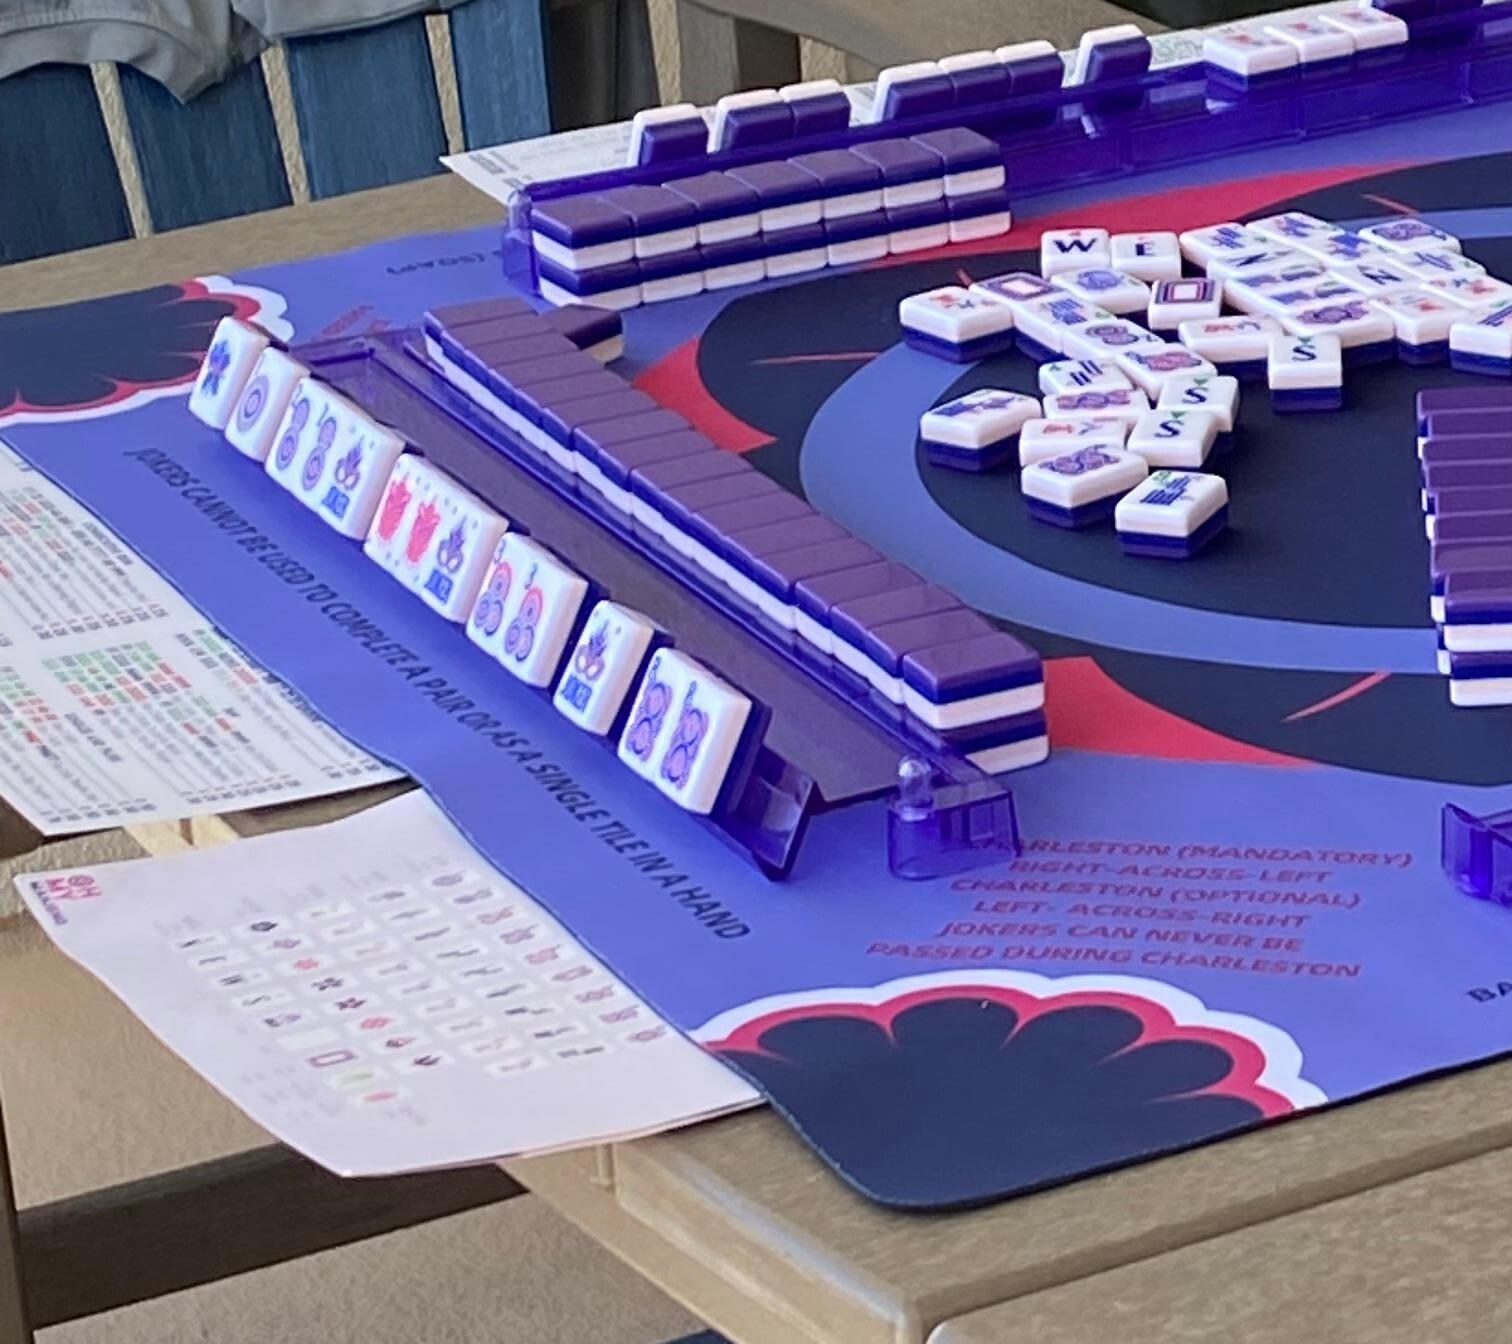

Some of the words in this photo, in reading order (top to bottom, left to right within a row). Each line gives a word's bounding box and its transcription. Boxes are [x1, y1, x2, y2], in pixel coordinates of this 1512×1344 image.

[1053, 238, 1097, 254] W
[1134, 241, 1155, 256] E
[1292, 344, 1317, 362] S
[1182, 387, 1207, 405] S
[1154, 419, 1182, 439] S
[181, 486, 258, 536] CANNOT
[237, 534, 279, 556] BE
[254, 552, 316, 586] USED
[300, 582, 339, 604] TO
[321, 601, 421, 667] COMPLETE
[414, 677, 476, 715] PAIR
[481, 730, 531, 749] AS
[525, 762, 612, 824] SINGLE
[590, 819, 651, 855] TILE
[628, 851, 675, 874] IN
[972, 838, 1171, 856] ARLESTON
[1177, 843, 1413, 868] (MANDATORY)
[651, 873, 690, 890] A
[1009, 860, 1333, 883] RIGHT-ACROSS-LEFT
[951, 878, 1163, 899] CHARLESTON
[1170, 887, 1362, 909] (OPTIONAL)
[670, 885, 751, 940] HAND
[1065, 903, 1311, 928] ACROSS-RIGHT
[935, 921, 1059, 938] JOKERS
[1067, 924, 1138, 940] CAN
[1145, 927, 1255, 949] NEVER
[1261, 936, 1306, 953] BE
[865, 941, 994, 960] PASSED
[1002, 944, 1132, 963] DURING
[1140, 950, 1362, 978] CHARLESTON
